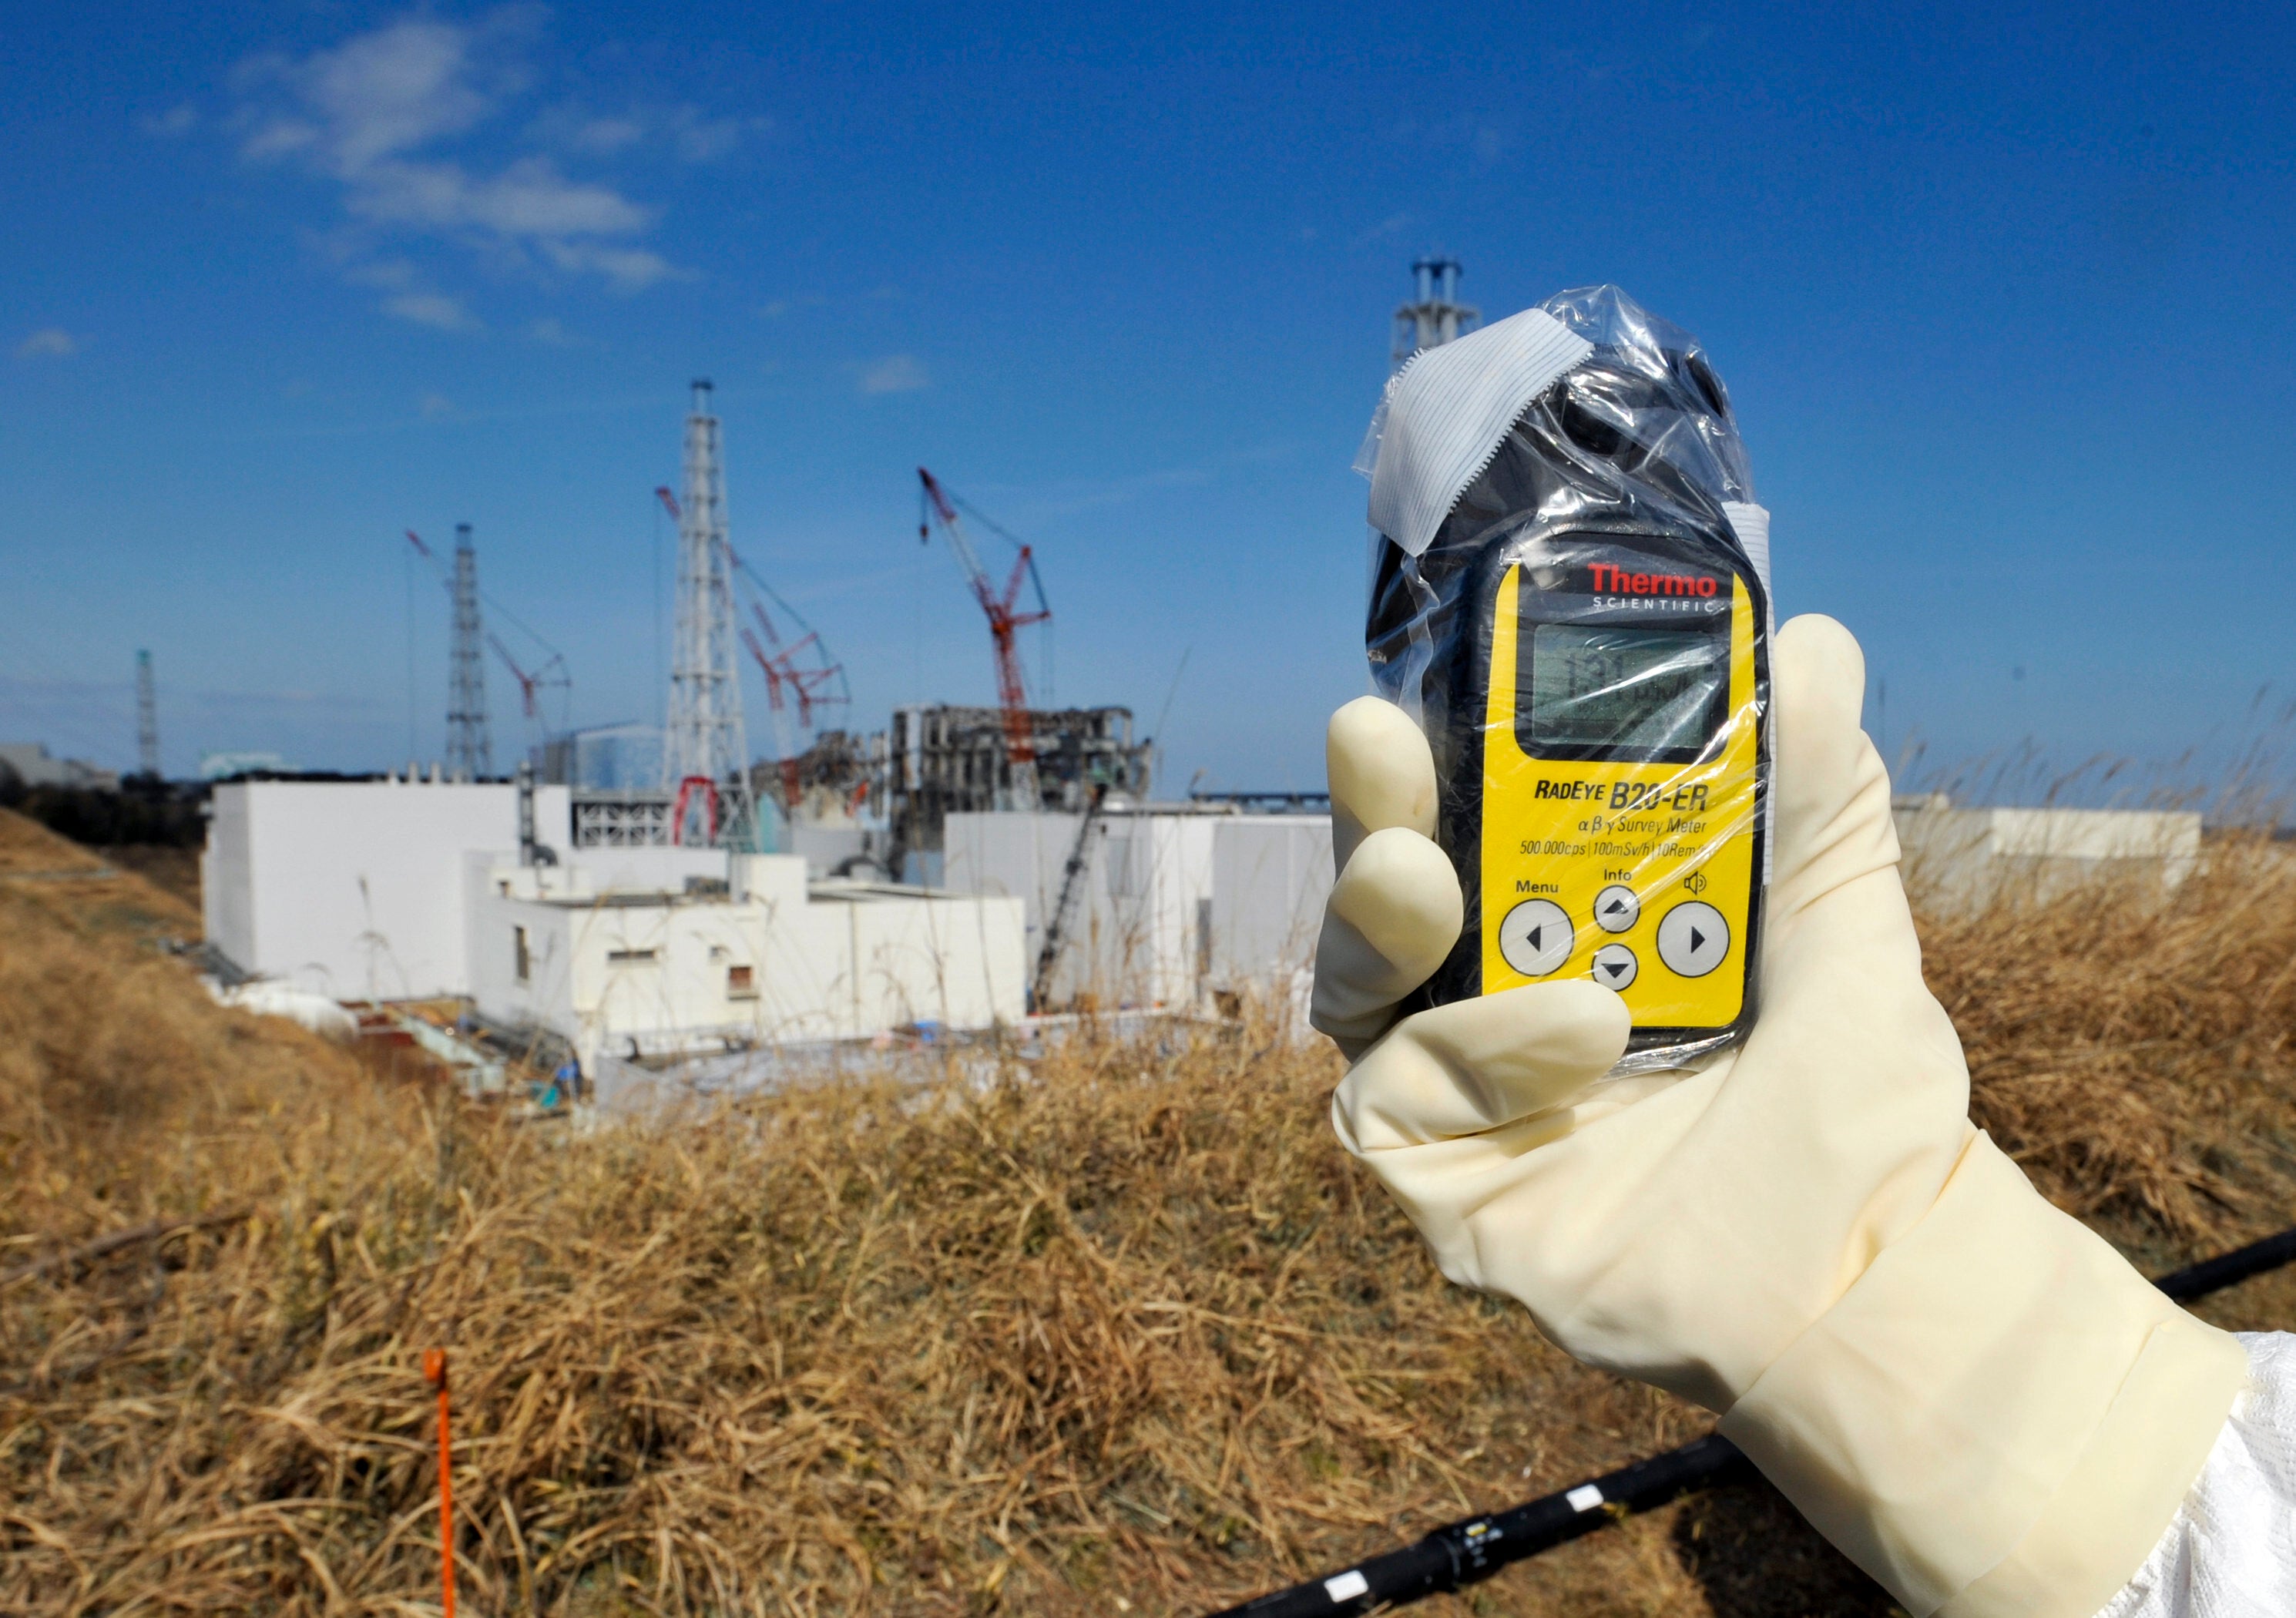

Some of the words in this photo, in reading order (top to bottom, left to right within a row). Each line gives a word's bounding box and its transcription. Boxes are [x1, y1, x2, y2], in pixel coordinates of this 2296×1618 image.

[1587, 562, 1717, 597] Thermo
[1593, 596, 1715, 613] SCIENTIFIC
[1610, 782, 1709, 811] B20-ER
[1617, 817, 1663, 836] Survey
[1667, 818, 1707, 834] Meter
[1593, 841, 1649, 856] 100mSv/h
[1657, 843, 1706, 857] 10Rem
[1603, 868, 1632, 882] Info
[1516, 880, 1559, 894] Menu
